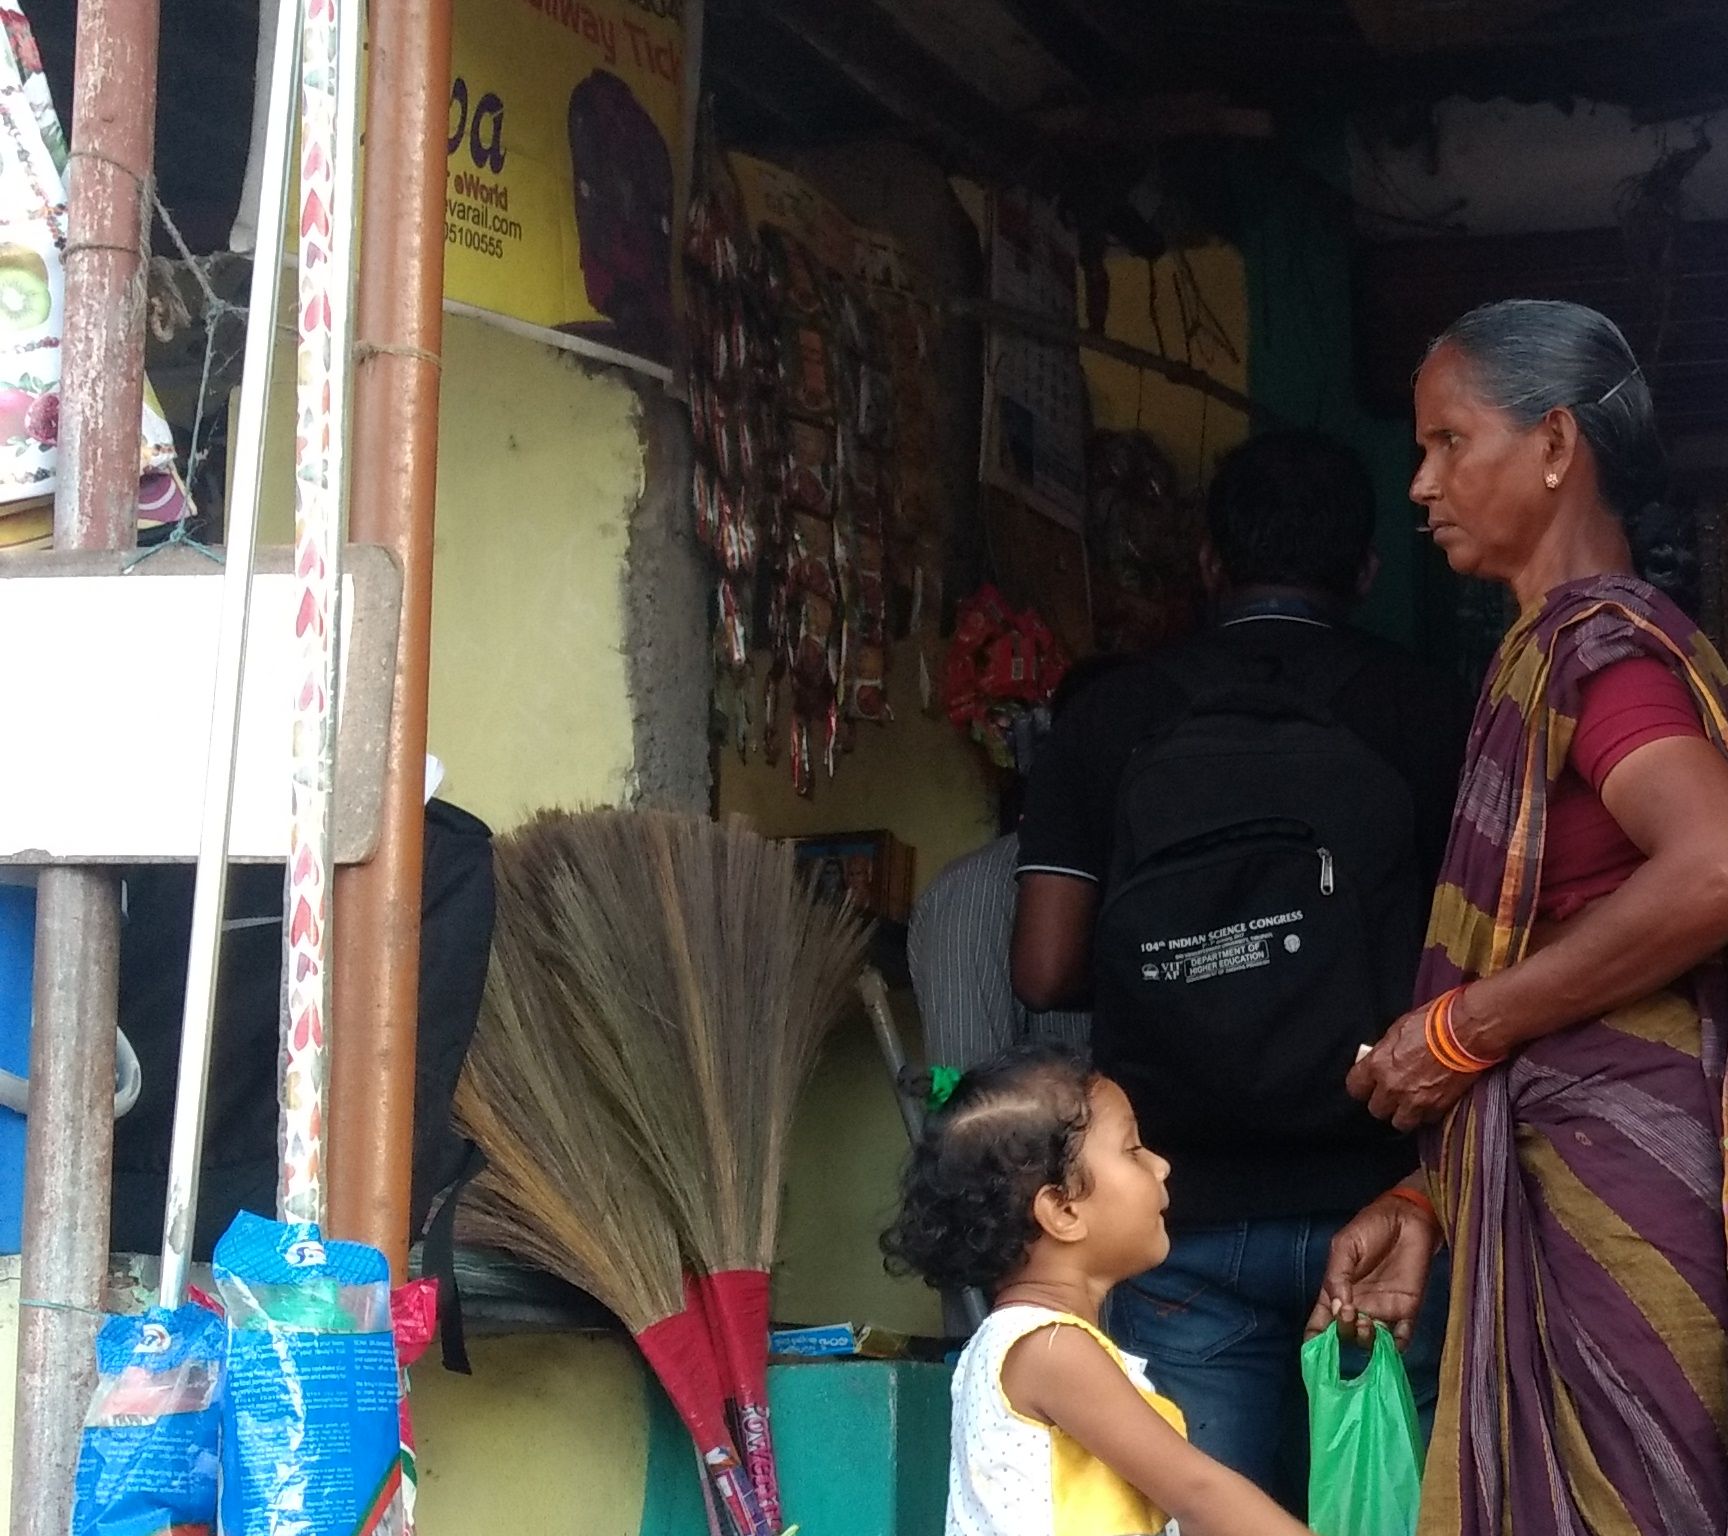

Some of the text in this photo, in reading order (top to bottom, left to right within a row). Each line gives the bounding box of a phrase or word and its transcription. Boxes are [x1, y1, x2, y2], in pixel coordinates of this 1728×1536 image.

[1168, 934, 1207, 951] INDIAN
[1207, 922, 1248, 941] SCIENCE
[1249, 909, 1305, 931] CONGRESS
[1188, 961, 1219, 976] HIGHER
[1218, 950, 1265, 969] EDUCATION
[1190, 945, 1246, 967] DEPARTMENT
